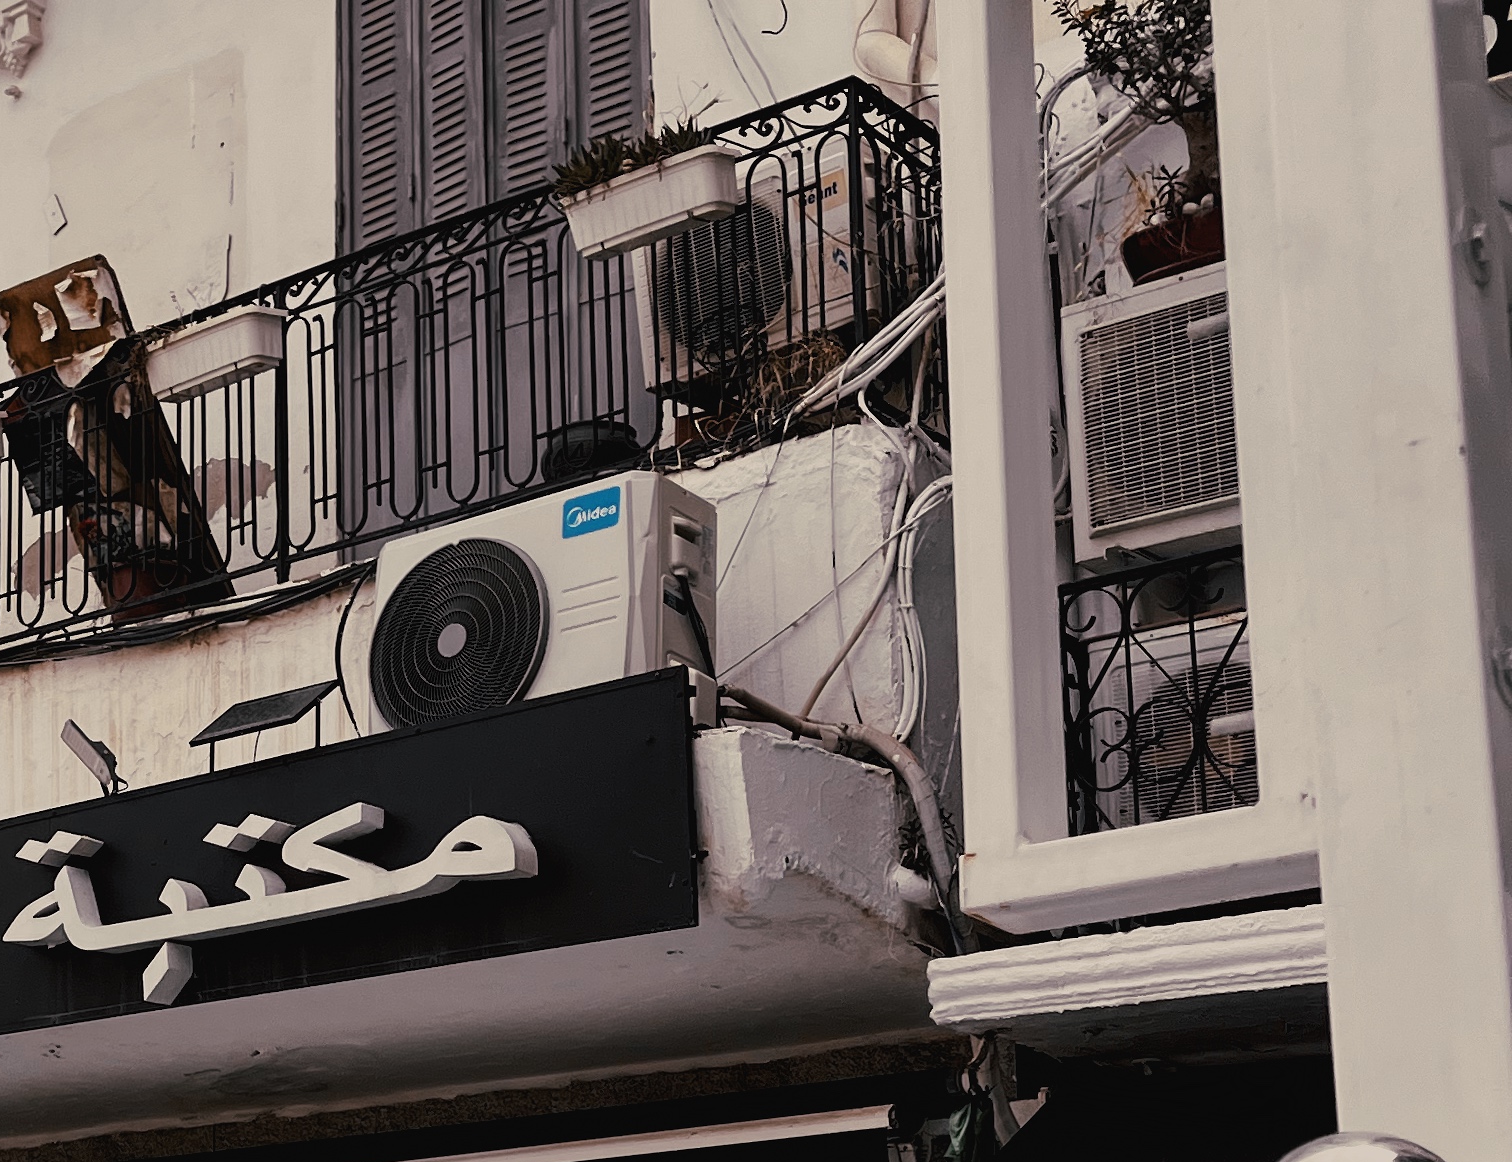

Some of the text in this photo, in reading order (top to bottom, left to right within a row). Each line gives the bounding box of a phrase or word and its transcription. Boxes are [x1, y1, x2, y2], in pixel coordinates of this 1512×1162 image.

[800, 182, 838, 206] ént
[567, 504, 617, 528] Midea
[2, 802, 539, 1006] مكتبة
